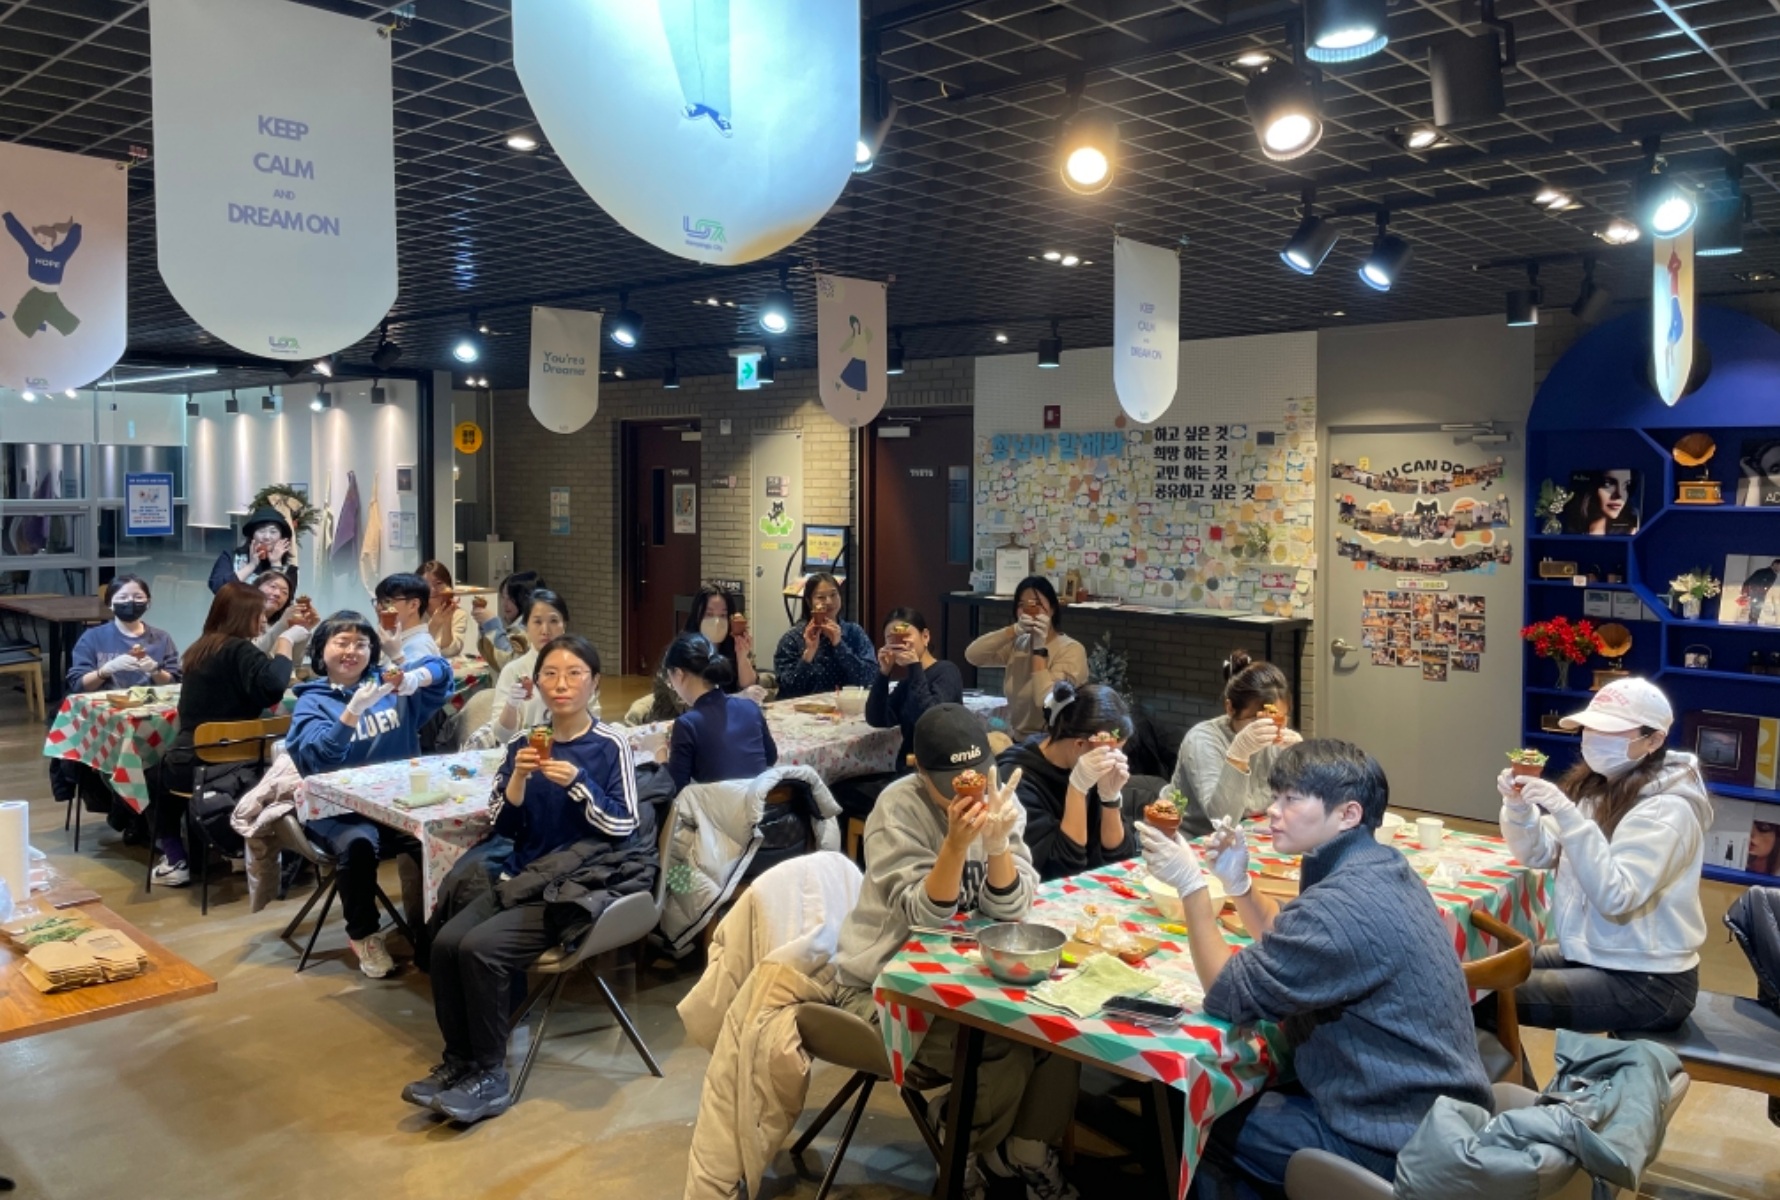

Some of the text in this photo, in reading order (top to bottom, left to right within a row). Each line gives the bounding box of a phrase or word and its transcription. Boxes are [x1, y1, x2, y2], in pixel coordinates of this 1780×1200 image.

[258, 115, 309, 141] KEEP
[253, 152, 314, 180] CALM
[273, 189, 296, 200] AND
[228, 203, 340, 236] DREAM ON
[35, 258, 61, 268] HOPE
[544, 350, 577, 364] You're
[543, 362, 587, 376] Dreamer
[1154, 425, 1228, 441] 하고 싶은 것
[1154, 445, 1228, 462] 희망 하는 것
[1154, 465, 1228, 481] 고민 하는 것
[1402, 460, 1438, 473] CAN
[1154, 483, 1255, 500] 공유하고 싶은 것
[950, 745, 982, 764] emis
